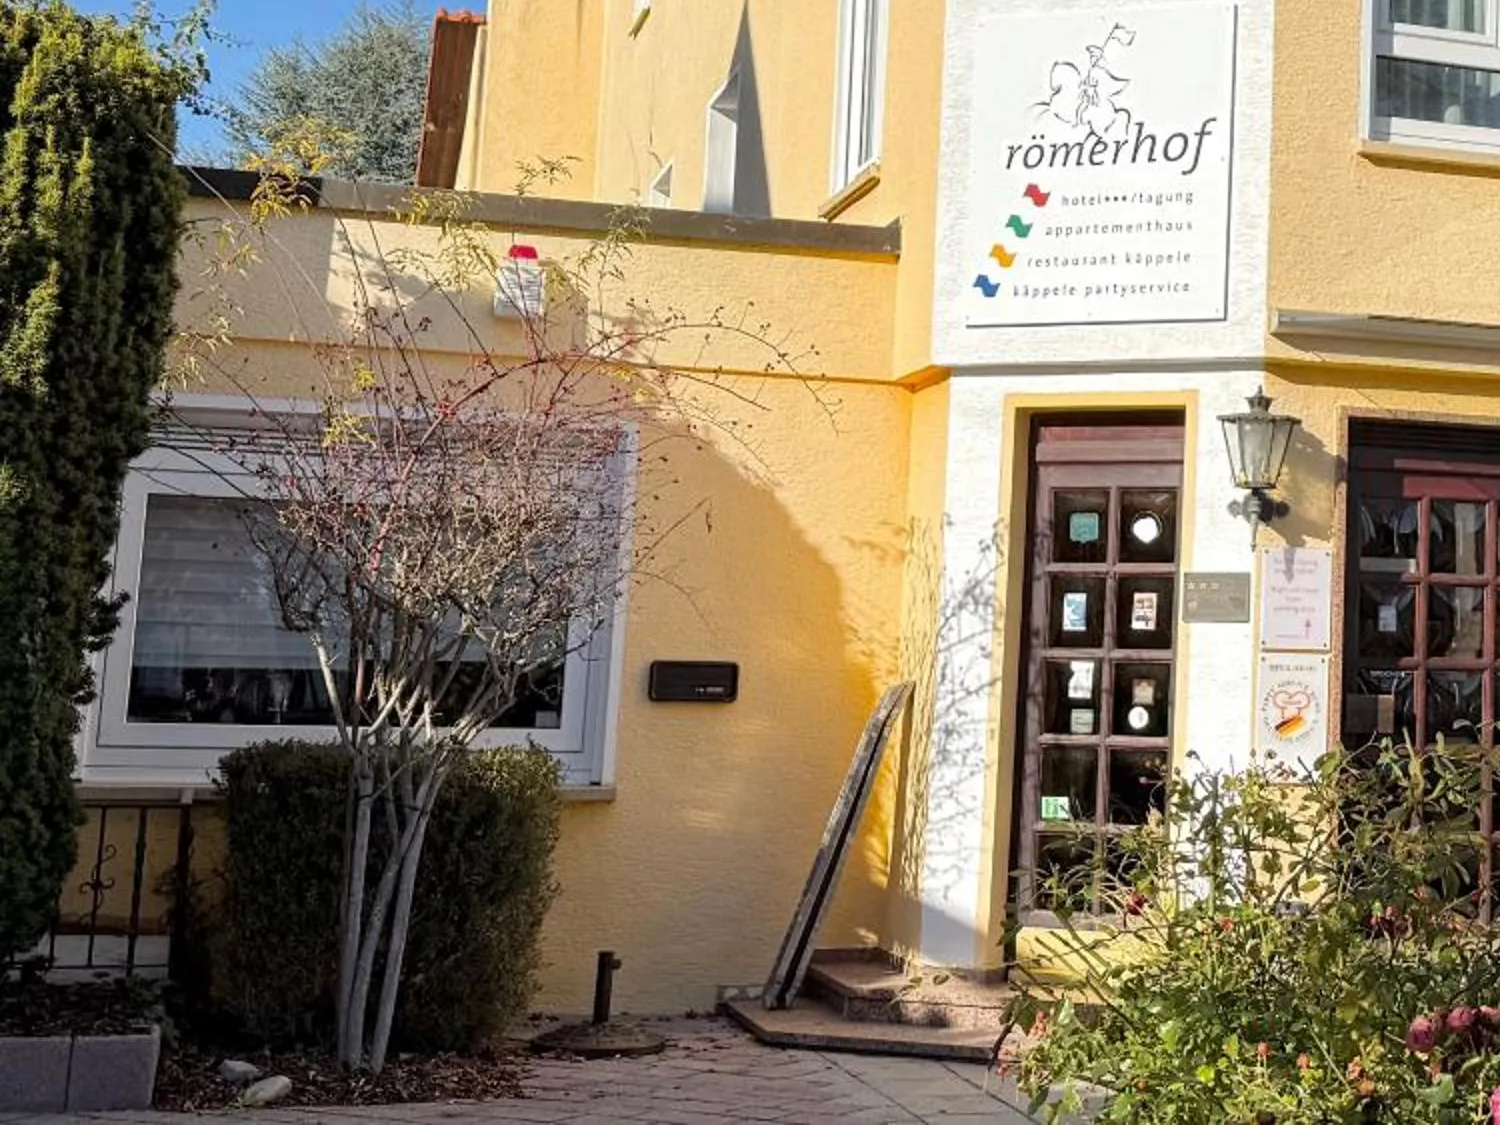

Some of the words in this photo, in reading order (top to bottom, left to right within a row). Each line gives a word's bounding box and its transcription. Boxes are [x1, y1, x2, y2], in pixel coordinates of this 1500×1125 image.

[1006, 117, 1218, 176] römerhof
[1045, 219, 1193, 239] appartementhaus
[1027, 253, 1117, 268] restaurant
[1125, 250, 1192, 267] käppele
[1013, 282, 1077, 299] käppele
[1084, 282, 1190, 299] partyservice
